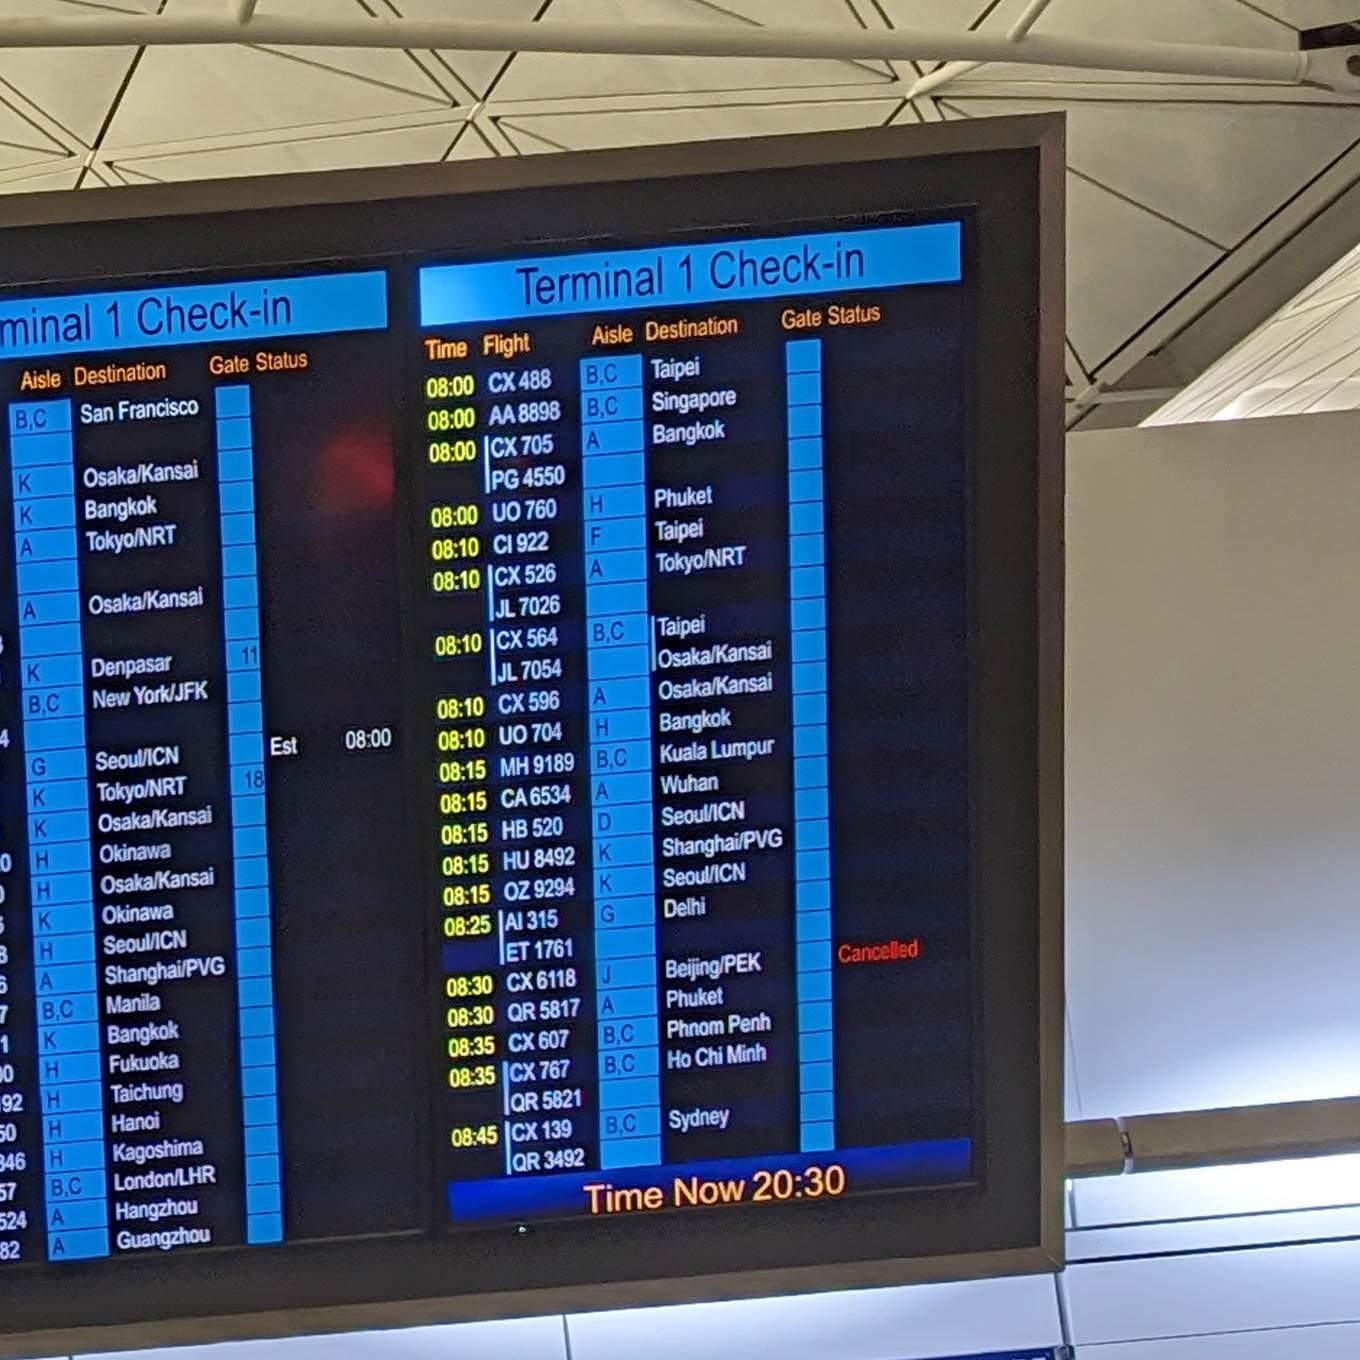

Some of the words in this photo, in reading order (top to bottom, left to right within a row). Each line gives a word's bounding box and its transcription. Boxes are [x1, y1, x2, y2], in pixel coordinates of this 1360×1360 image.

[515, 256, 662, 305] Terminal
[679, 254, 691, 292] 1
[710, 240, 864, 289] Check-in
[106, 300, 119, 337] 1
[137, 288, 291, 335] Check-in
[426, 374, 474, 398] 08:00
[488, 371, 516, 393] CX
[518, 368, 552, 390] 488
[650, 356, 699, 381] Taipei
[80, 404, 114, 423] San
[118, 397, 199, 420] Francisco
[652, 389, 737, 414] Singapore
[83, 458, 198, 488] Osaka/Kansai
[654, 486, 712, 508] Phuket
[85, 524, 176, 554] Tokyo/NRT
[431, 536, 479, 560] 08:10
[655, 545, 747, 575] Tokyo/NRT
[91, 656, 172, 679] Denpasar
[92, 689, 131, 708] New
[133, 680, 208, 704] York/JFK
[270, 736, 297, 756] Est
[345, 727, 391, 749] 08:00
[660, 742, 707, 763] Kuala
[711, 739, 775, 760] Lumpur
[660, 774, 718, 794] Wuhan
[661, 800, 745, 826] Seoul/ICN
[99, 843, 171, 863] Okinawa
[664, 896, 706, 918] Delhi
[665, 952, 761, 981] Beijing/PEK
[838, 939, 919, 963] Cancelled
[448, 1035, 495, 1058] 08:35
[667, 1019, 724, 1038] Phnom
[728, 1012, 771, 1033] Penh
[109, 1051, 179, 1073] Fukuoka
[110, 1082, 183, 1103] Taichung
[451, 1125, 498, 1147] 08:45
[669, 1108, 729, 1132] Sydney
[113, 1139, 203, 1164] Kagoshima
[582, 1183, 664, 1214] Time
[674, 1176, 746, 1207] Now
[752, 1164, 845, 1201] 20:30
[116, 1226, 211, 1250] Guangzhou
